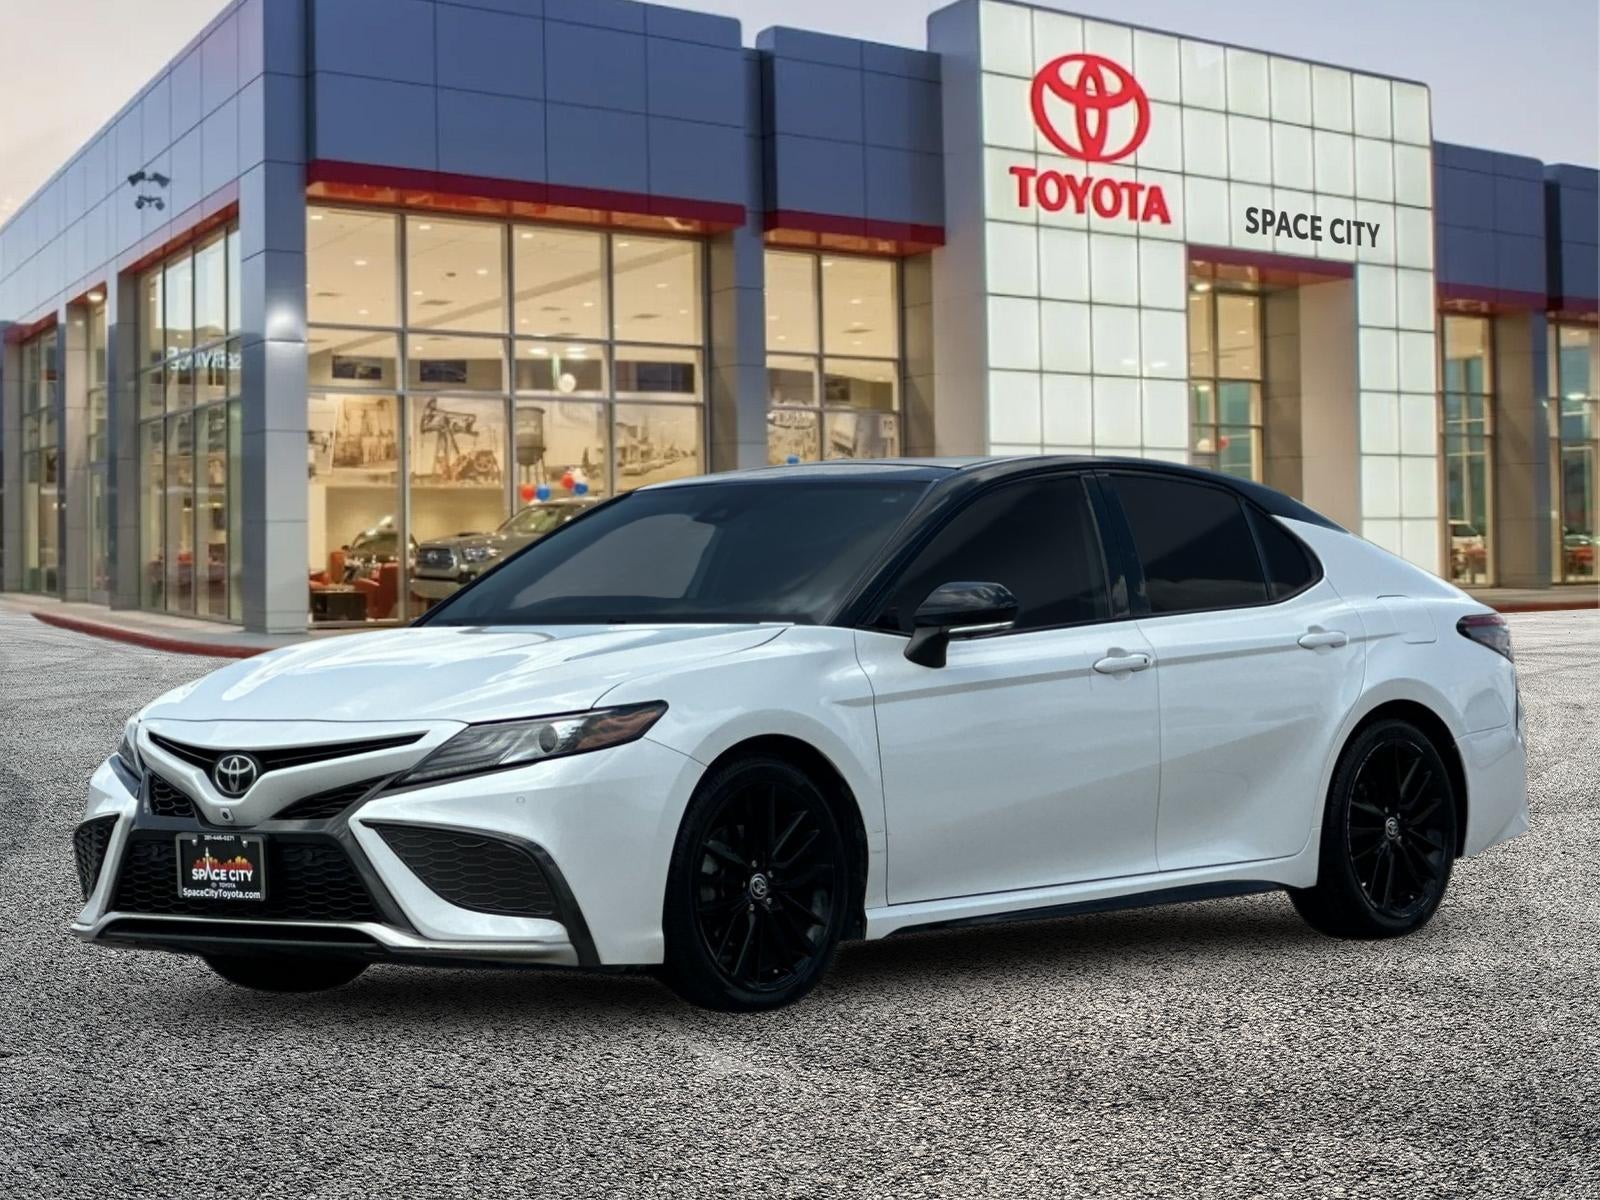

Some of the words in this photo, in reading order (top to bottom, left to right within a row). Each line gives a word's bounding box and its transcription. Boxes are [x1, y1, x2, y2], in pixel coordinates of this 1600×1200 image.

[1009, 166, 1171, 225] TOYOTA
[1245, 206, 1323, 242] SPACE
[1329, 217, 1381, 248] CITY
[192, 868, 227, 881] SPACE
[228, 869, 253, 882] CITY
[183, 888, 260, 899] SpaceCityToyota.com
